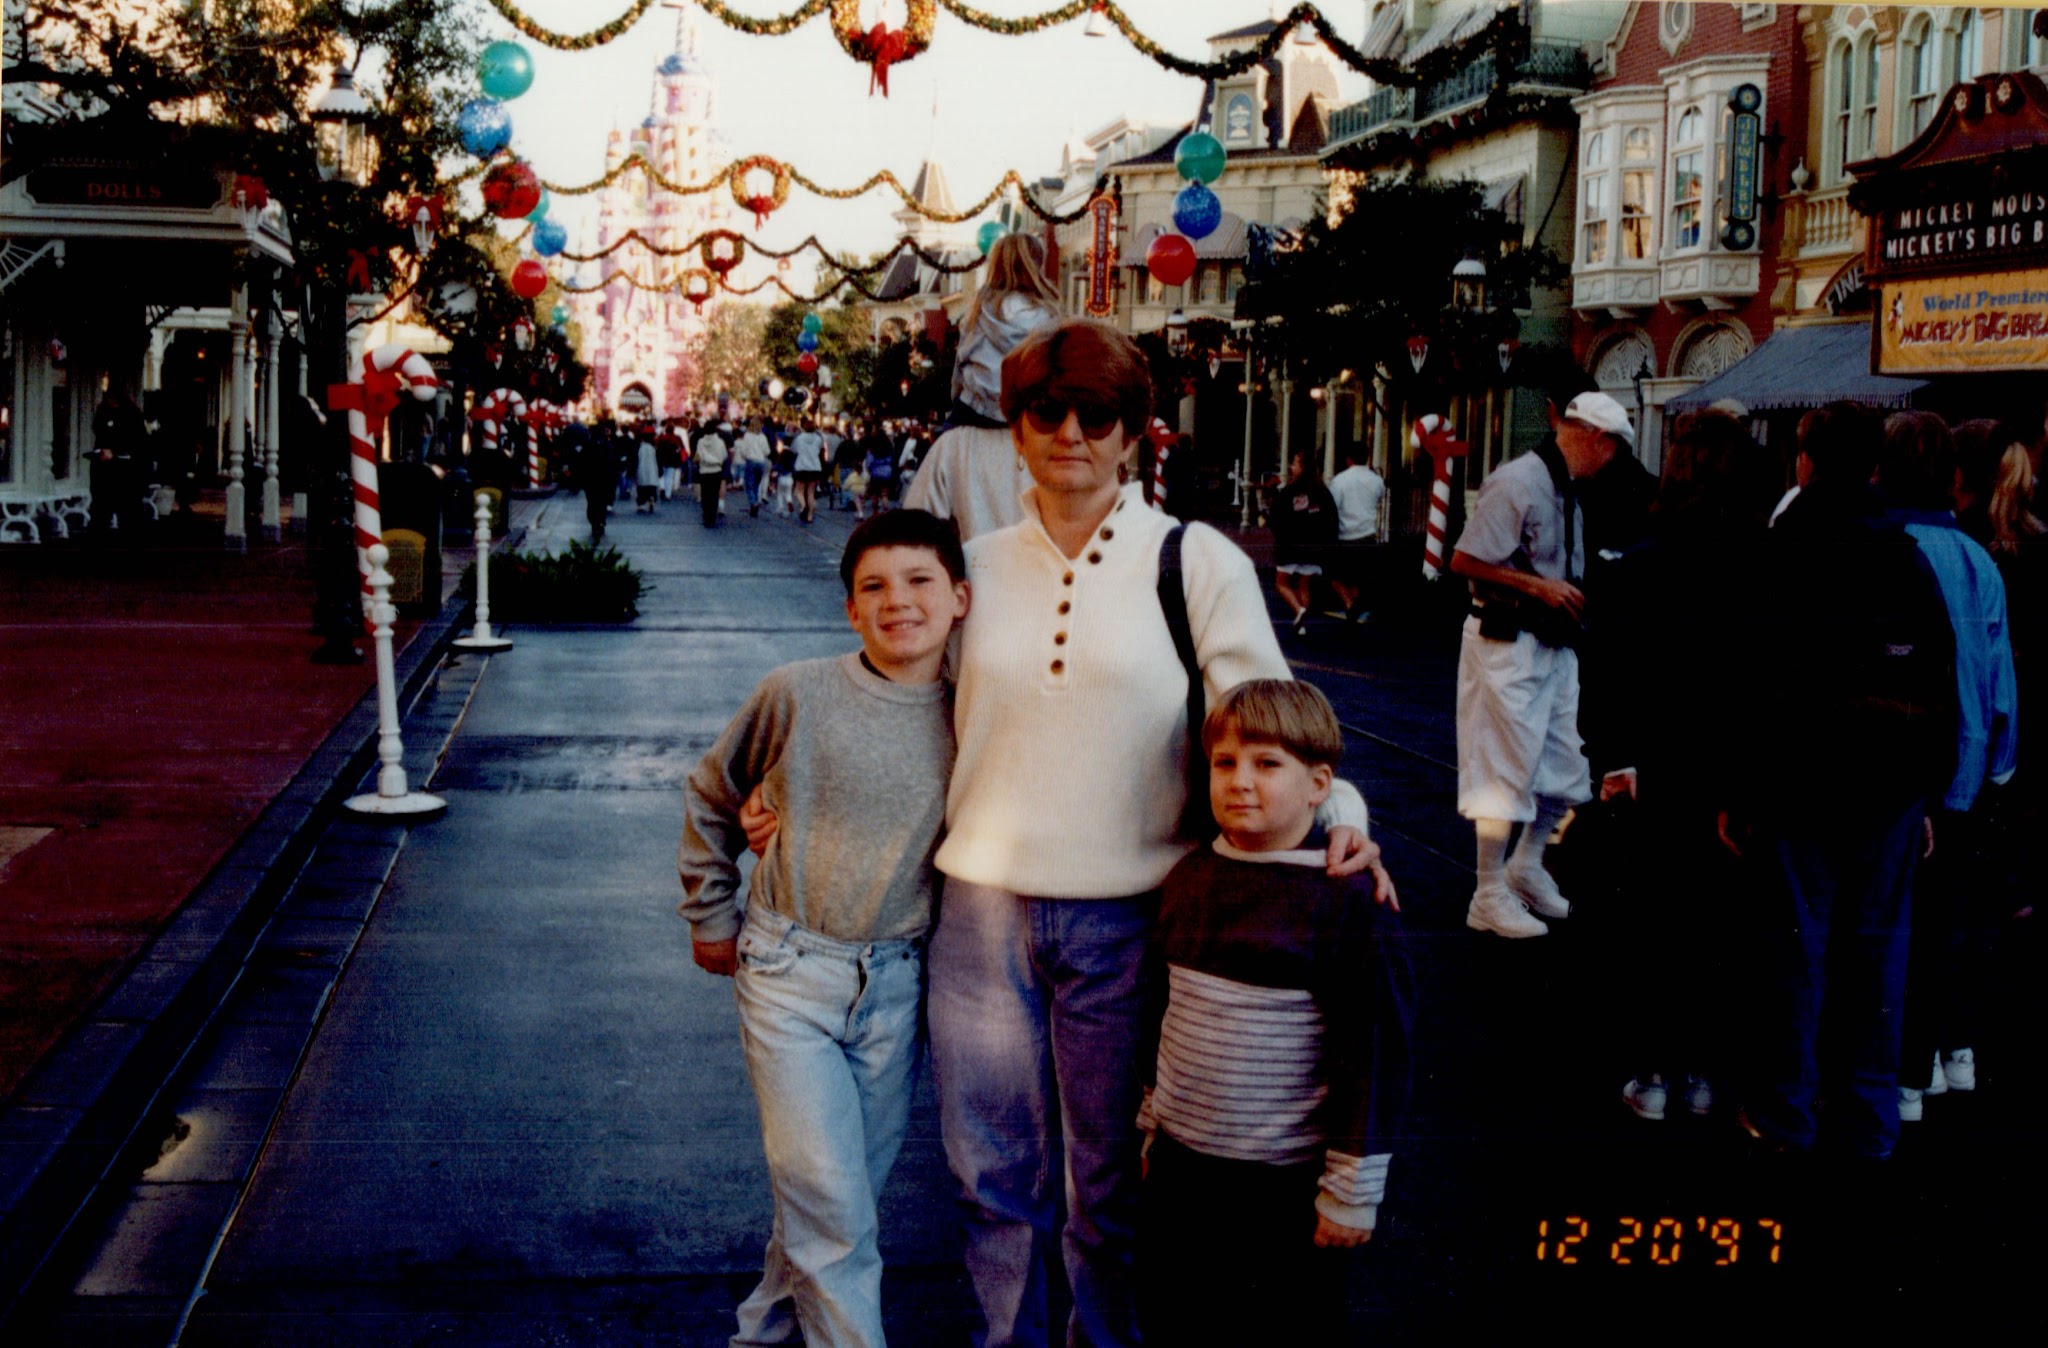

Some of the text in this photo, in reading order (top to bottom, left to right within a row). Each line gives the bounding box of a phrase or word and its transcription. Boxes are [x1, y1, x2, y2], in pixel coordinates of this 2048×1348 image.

[86, 180, 163, 199] DOLLS
[1900, 201, 1975, 230] MICKEY
[1886, 228, 1976, 259] MICKEY'S
[1986, 222, 2021, 248] BIG
[1923, 293, 1971, 312] World
[1974, 311, 2009, 345] BIG
